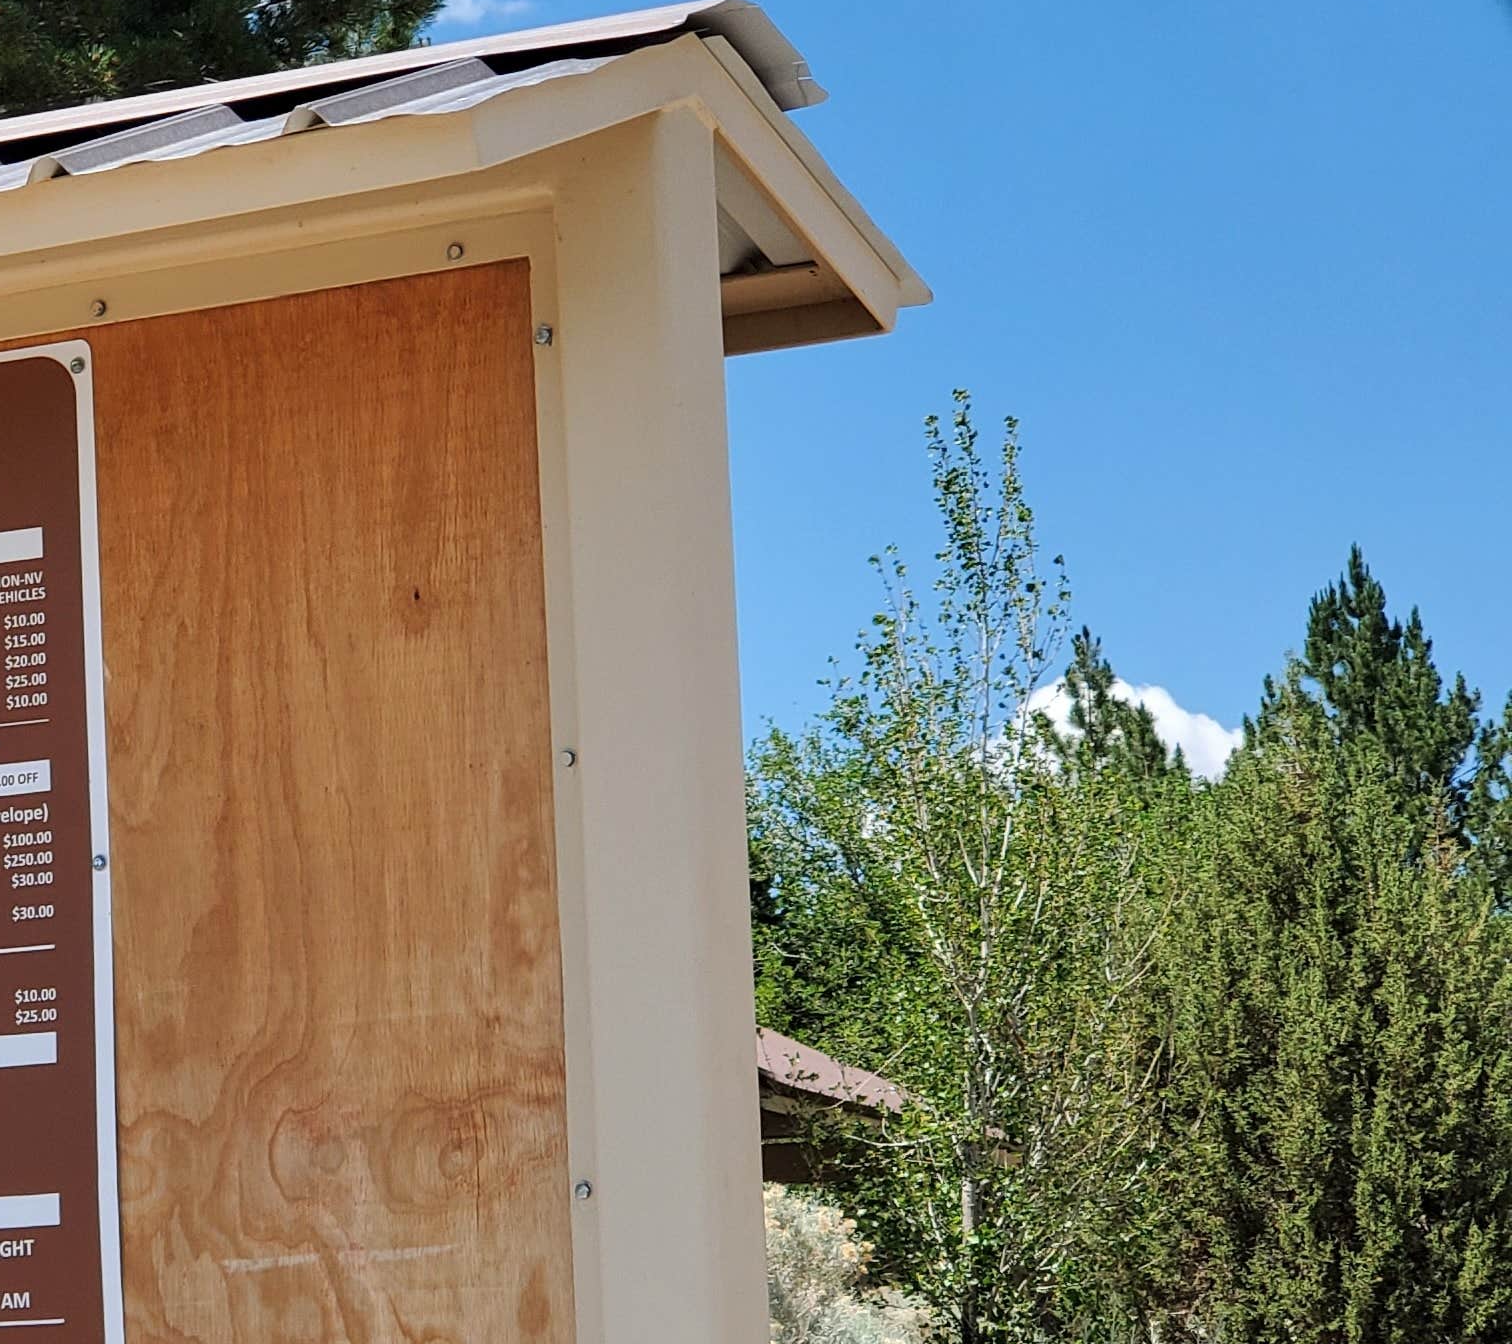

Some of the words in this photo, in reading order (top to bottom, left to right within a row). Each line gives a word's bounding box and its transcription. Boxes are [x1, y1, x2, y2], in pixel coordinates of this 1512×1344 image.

[3, 611, 45, 630] $10.00
[5, 672, 47, 690] $25.00
[5, 692, 48, 710] $10.00
[17, 771, 38, 785] OFF
[0, 1291, 30, 1309] AM
